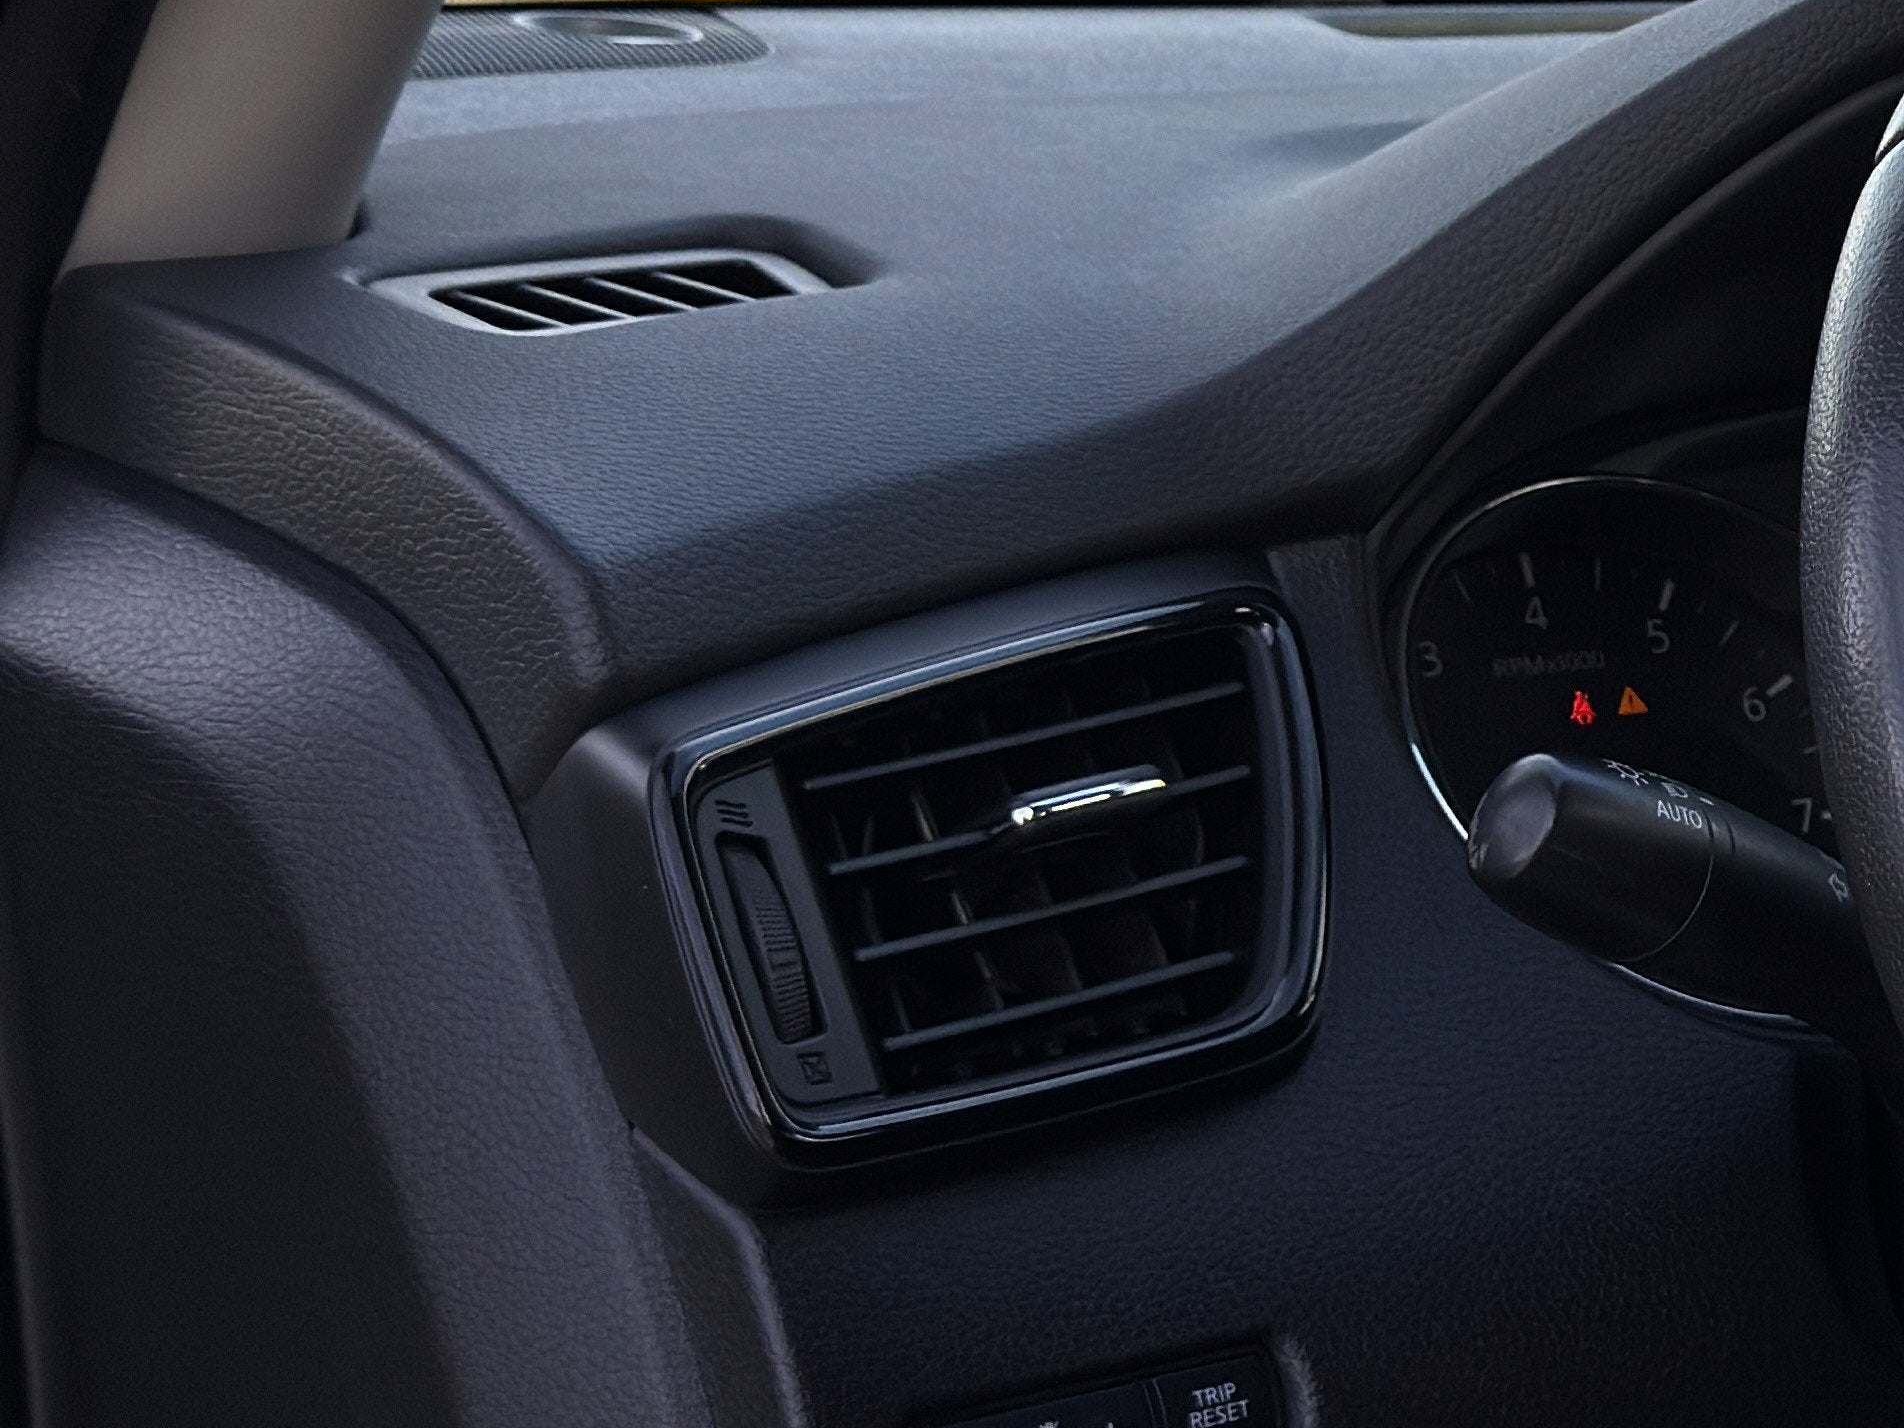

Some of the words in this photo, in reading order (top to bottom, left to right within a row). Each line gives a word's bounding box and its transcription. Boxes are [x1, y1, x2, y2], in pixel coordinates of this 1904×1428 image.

[1523, 596, 1549, 631] 4
[1646, 618, 1670, 655] 5
[1417, 640, 1444, 678] 3
[1741, 685, 1768, 723] 6
[1655, 799, 1703, 830] AUTO
[1790, 796, 1815, 834] 7
[1191, 1381, 1237, 1408] TRIP
